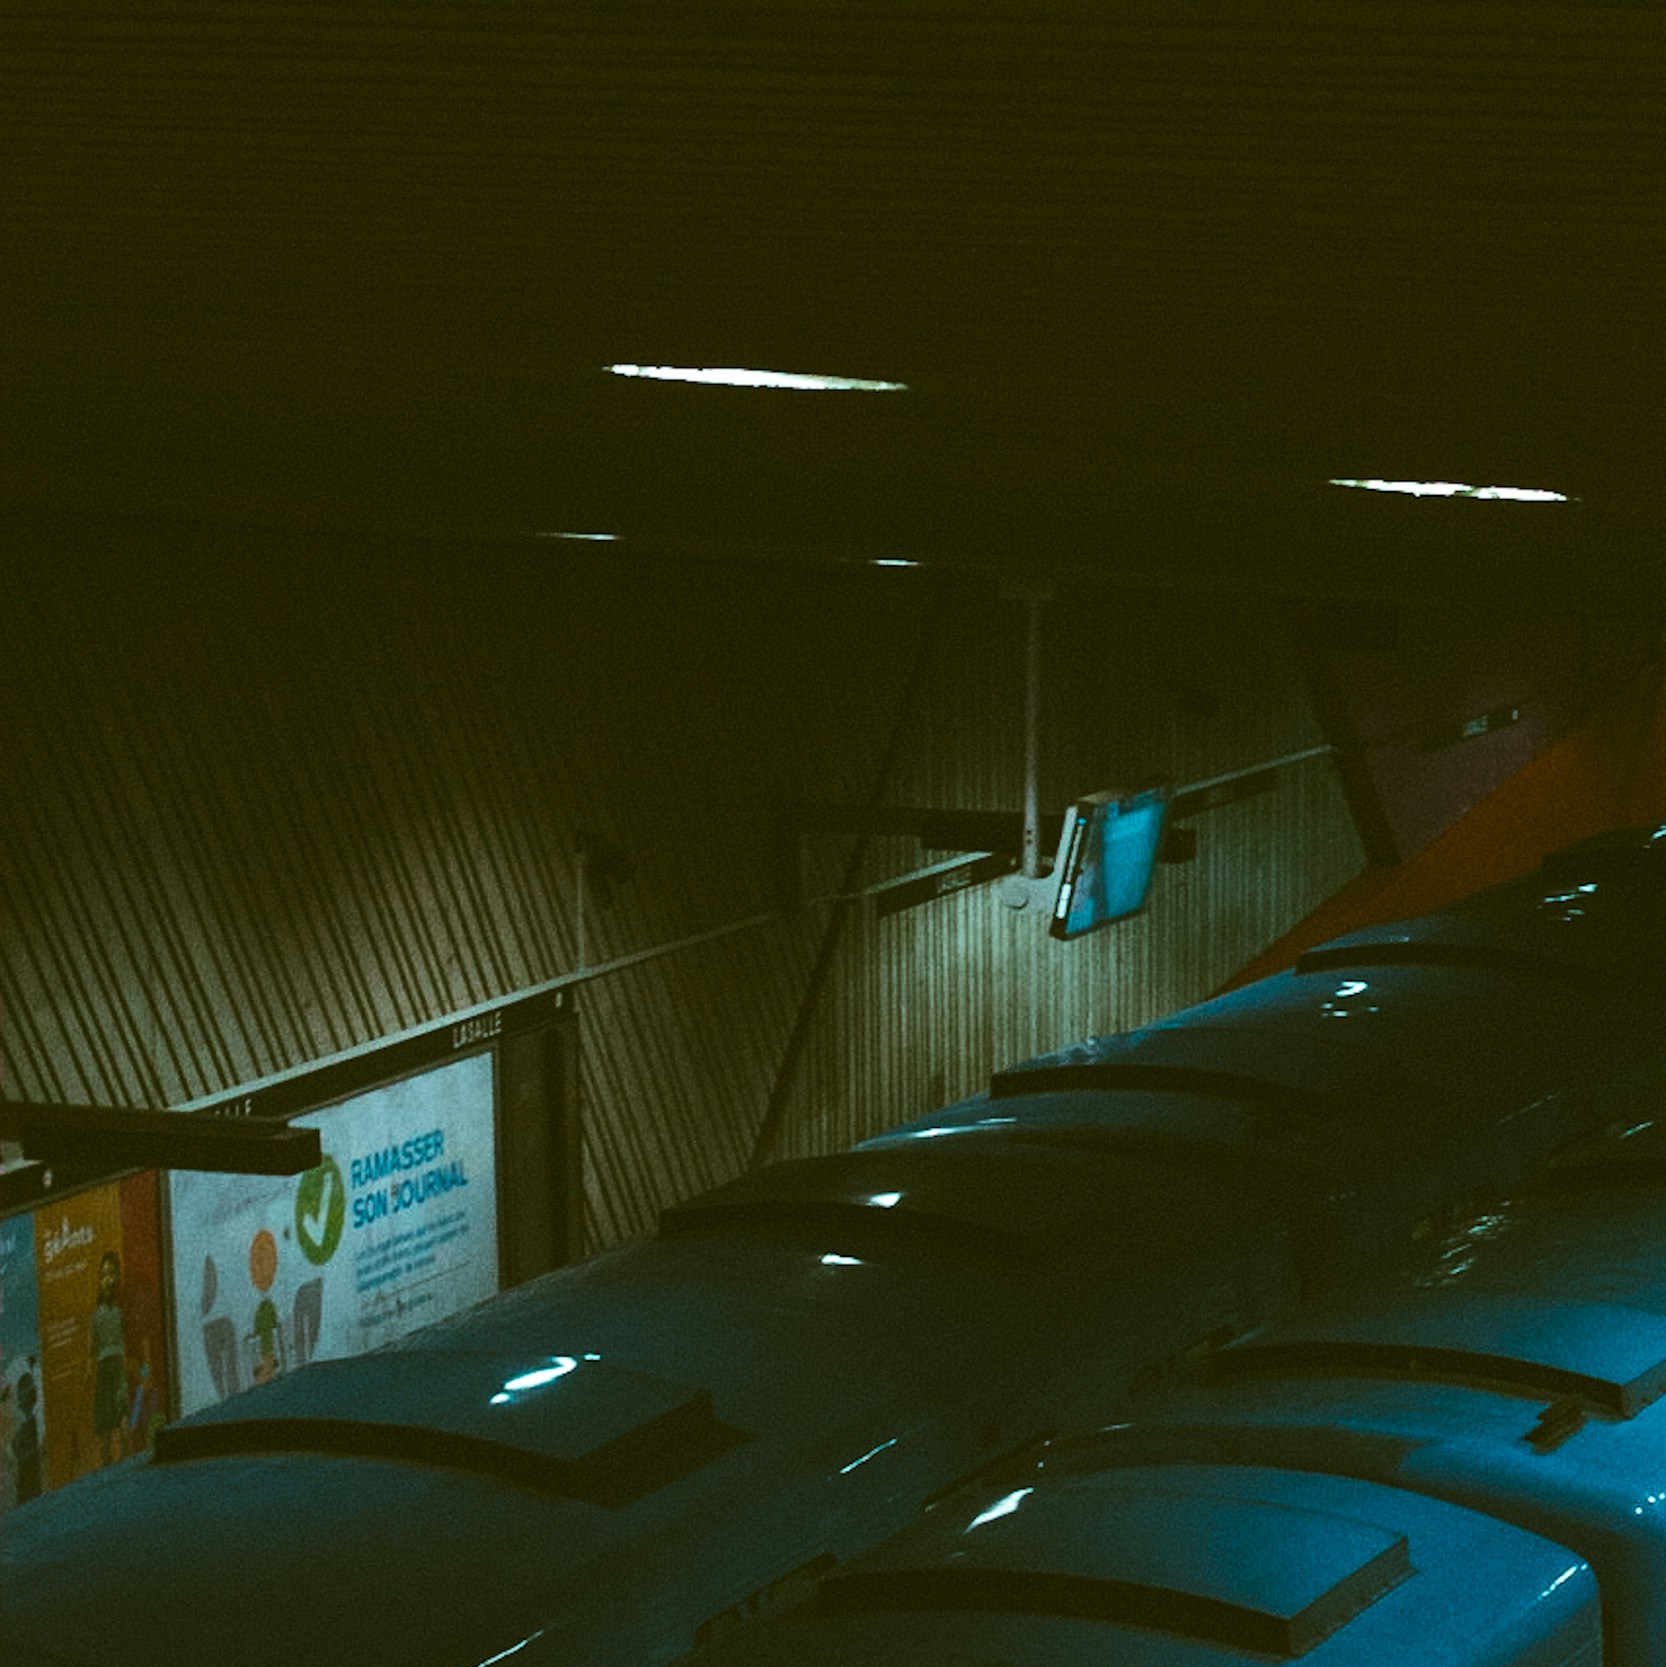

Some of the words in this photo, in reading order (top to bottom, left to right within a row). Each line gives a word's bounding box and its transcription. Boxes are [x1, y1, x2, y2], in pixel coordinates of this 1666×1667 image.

[352, 1129, 444, 1190] RAMASSER
[353, 1190, 388, 1228] SON
[393, 1159, 468, 1213] JOURNAL
